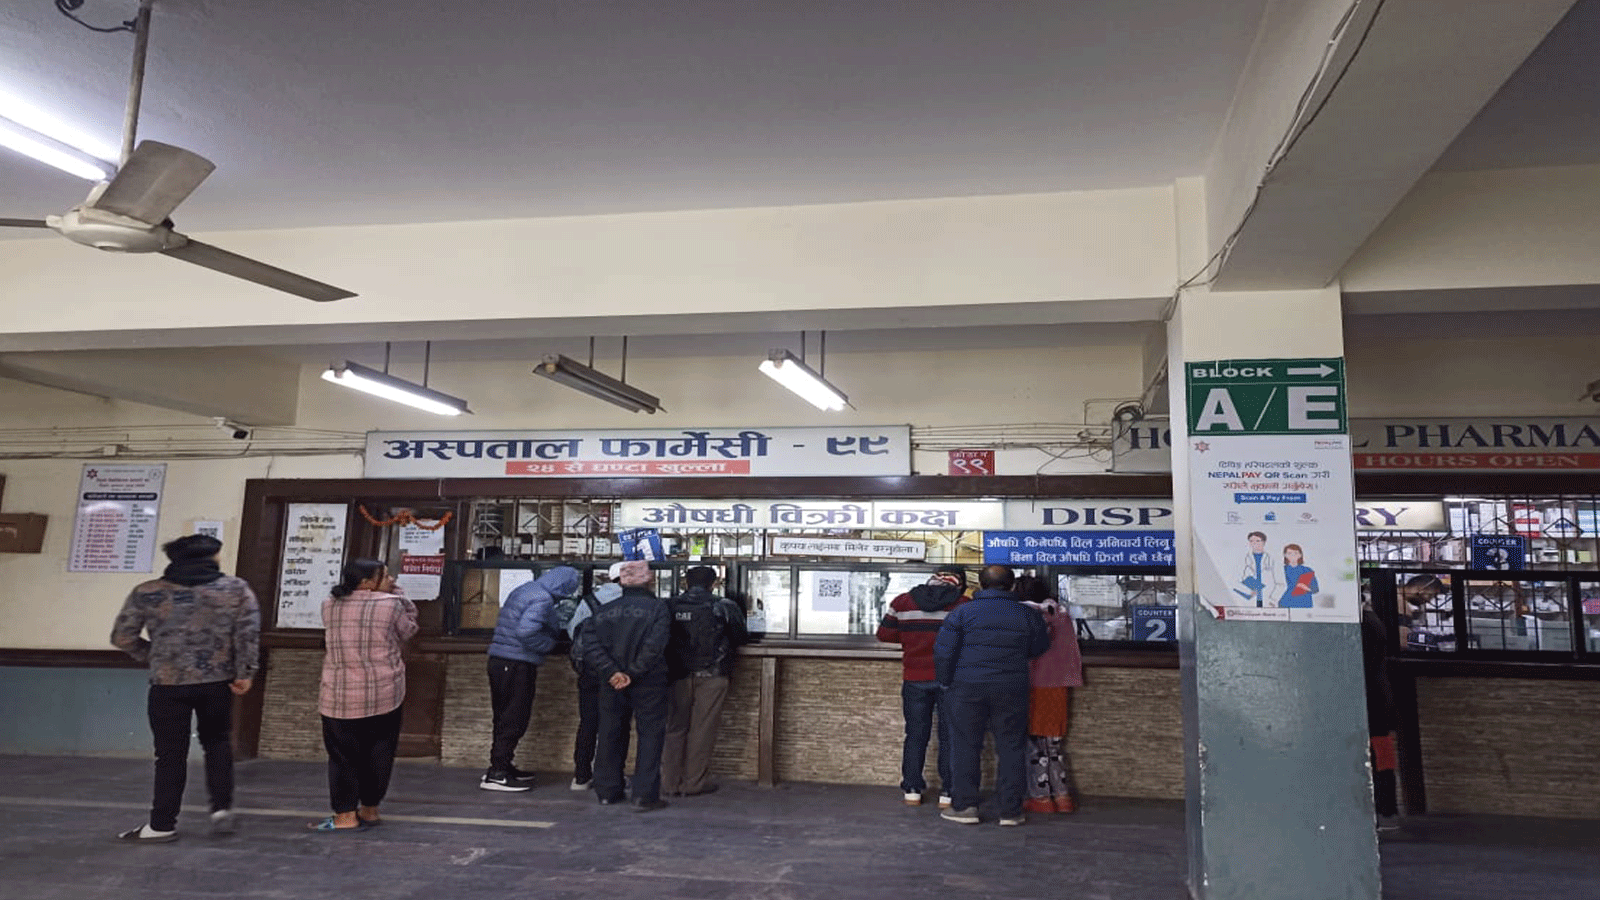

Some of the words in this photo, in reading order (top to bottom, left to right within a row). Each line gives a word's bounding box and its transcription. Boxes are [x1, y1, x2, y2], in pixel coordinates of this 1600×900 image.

[1192, 367, 1273, 379] BLOCK
[383, 438, 584, 460] अस्पताल
[599, 430, 773, 459] फार्मेसी
[1365, 455, 1477, 468] HOURS
[1489, 455, 1580, 468] OPEN
[592, 463, 647, 473] घण्टा
[655, 463, 727, 474] खुल्ला
[1208, 471, 1261, 479] NEPALPAY
[1264, 471, 1280, 479] QR
[1282, 471, 1308, 479] Scan
[642, 502, 757, 524] औषधी
[880, 509, 960, 527] कक्ष
[1096, 536, 1142, 548] अनिवार्य
[675, 612, 692, 621] CAT
[1137, 609, 1174, 617] COUNTER
[1145, 619, 1167, 641] 2
